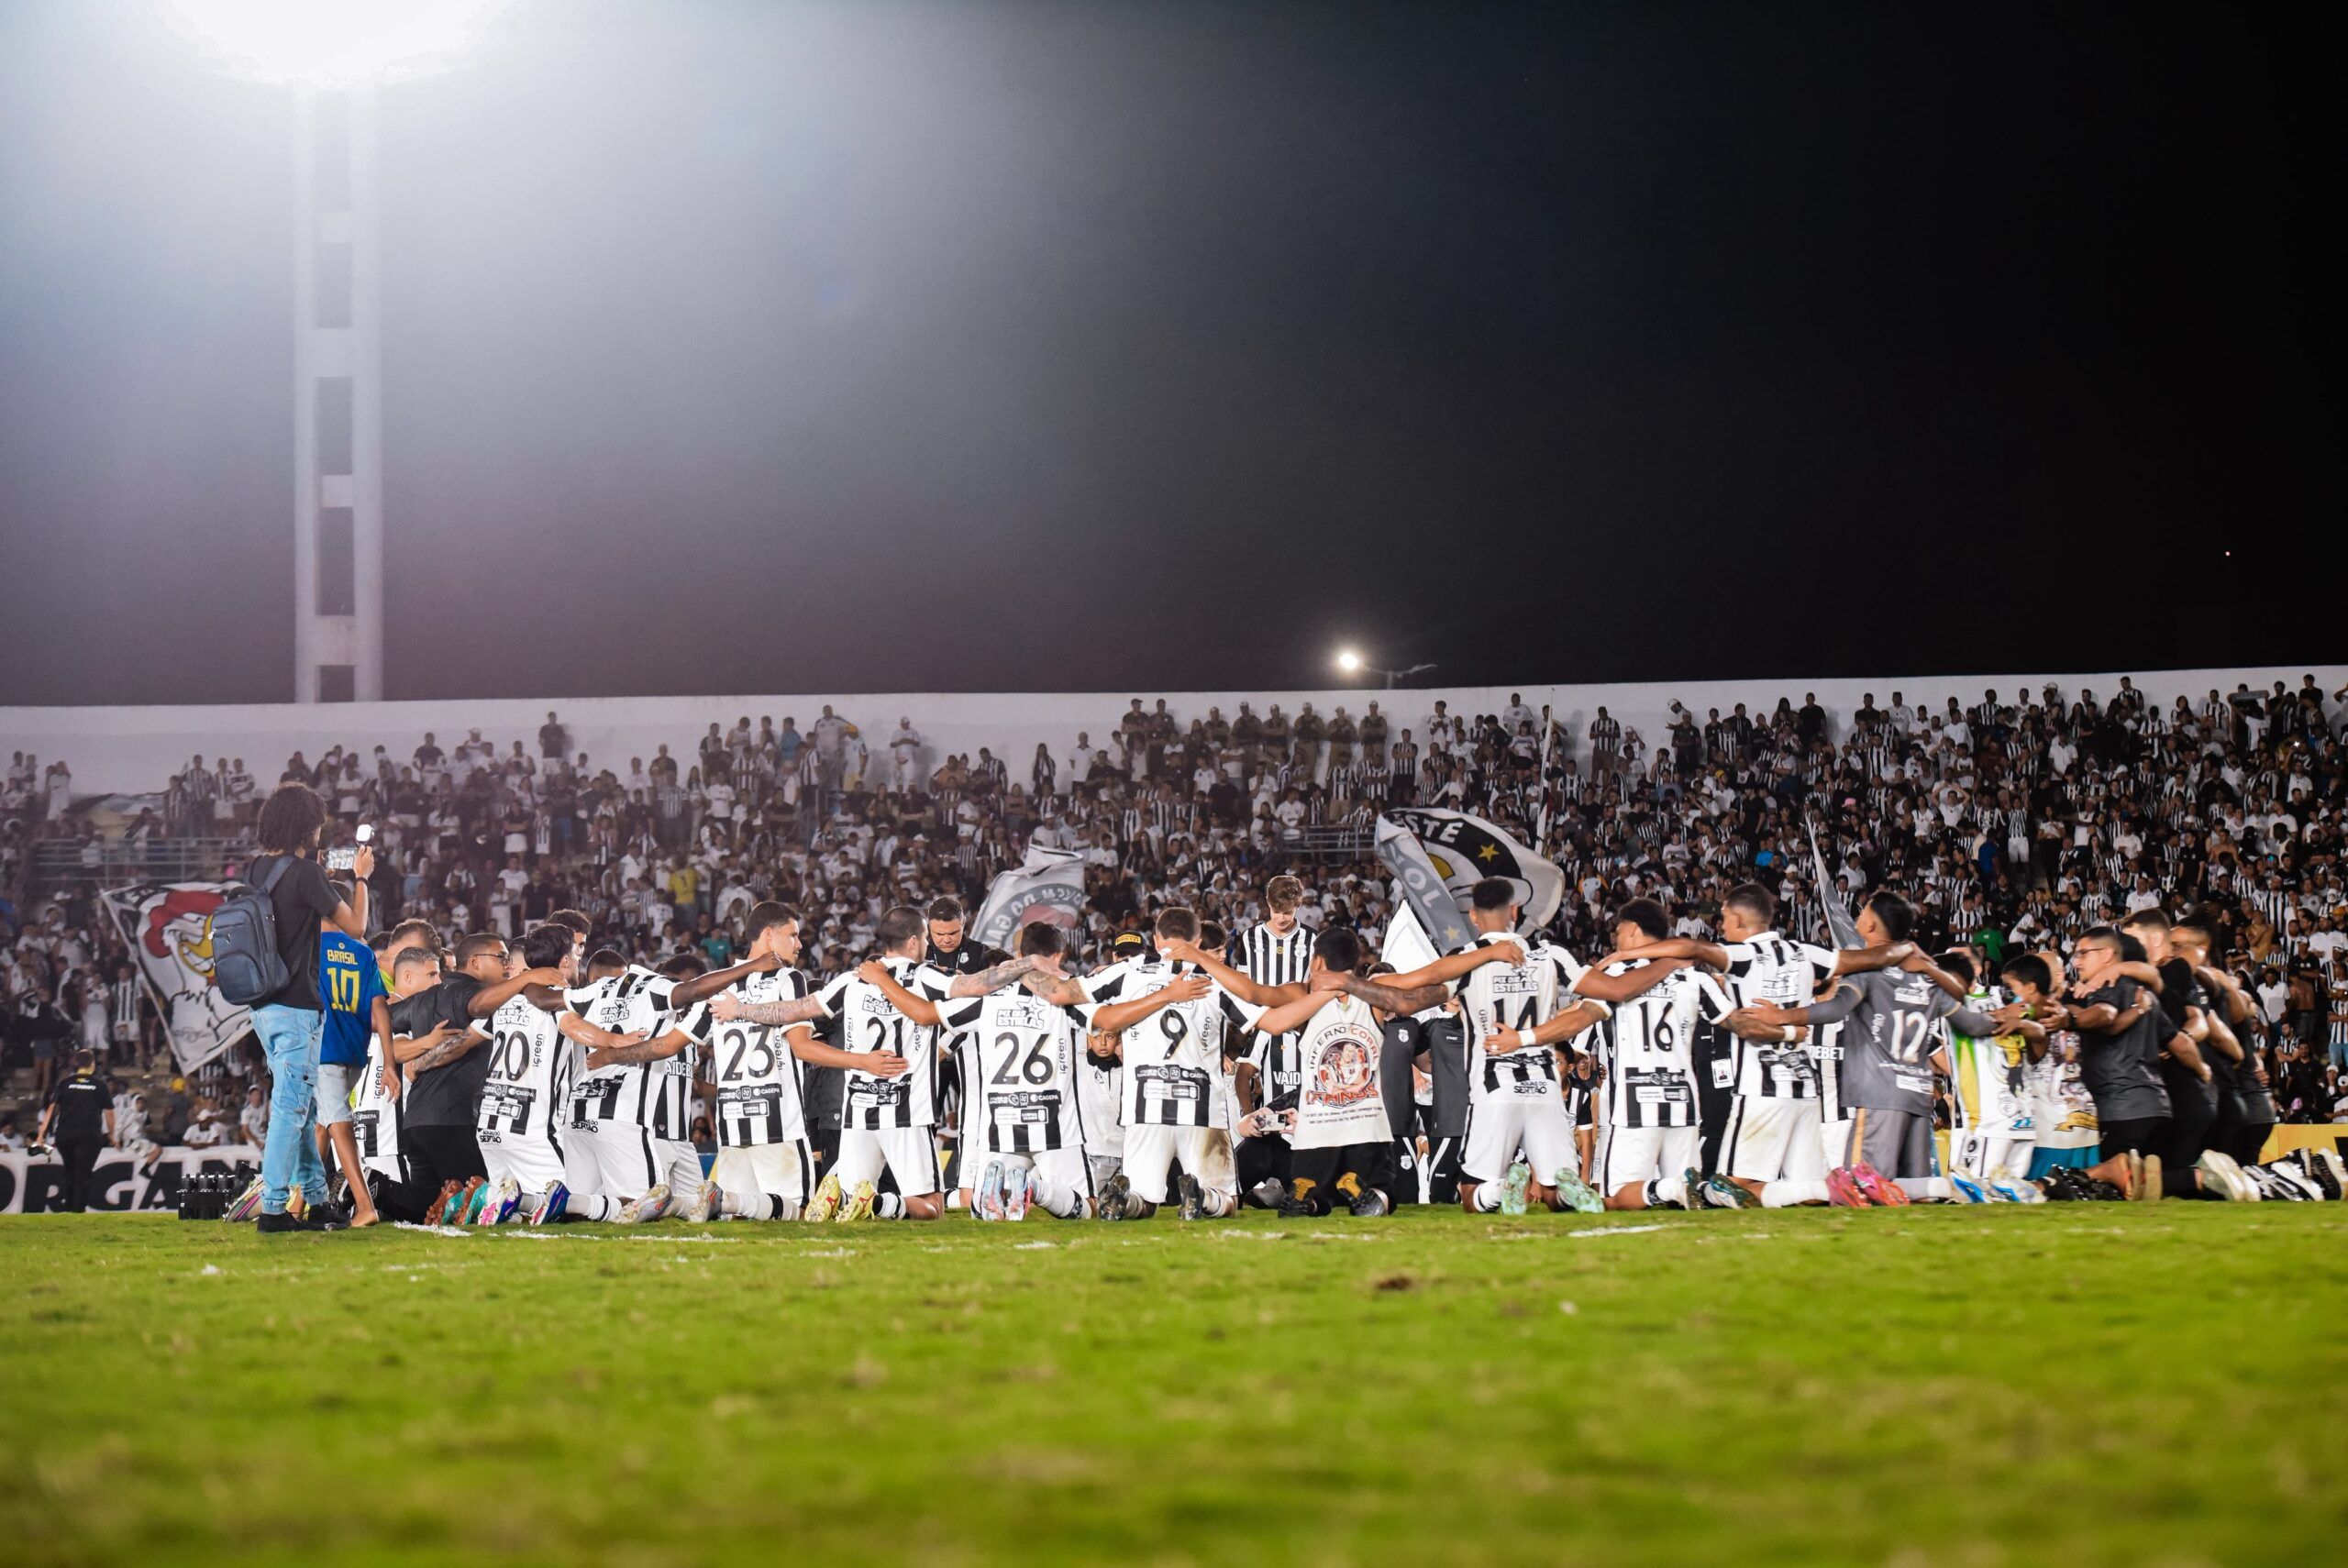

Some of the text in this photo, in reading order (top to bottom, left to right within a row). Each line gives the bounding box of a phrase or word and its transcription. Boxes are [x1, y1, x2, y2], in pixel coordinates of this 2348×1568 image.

[327, 949, 359, 966] BRASIL
[327, 967, 360, 1013] 10
[1159, 1009, 1189, 1060] 9
[1639, 1001, 1674, 1052] 16
[1890, 1010, 1928, 1063] 12
[488, 1030, 530, 1081] 20
[721, 1025, 776, 1081] 23
[991, 1032, 1054, 1085] 26
[1273, 1071, 1301, 1086] VAID
